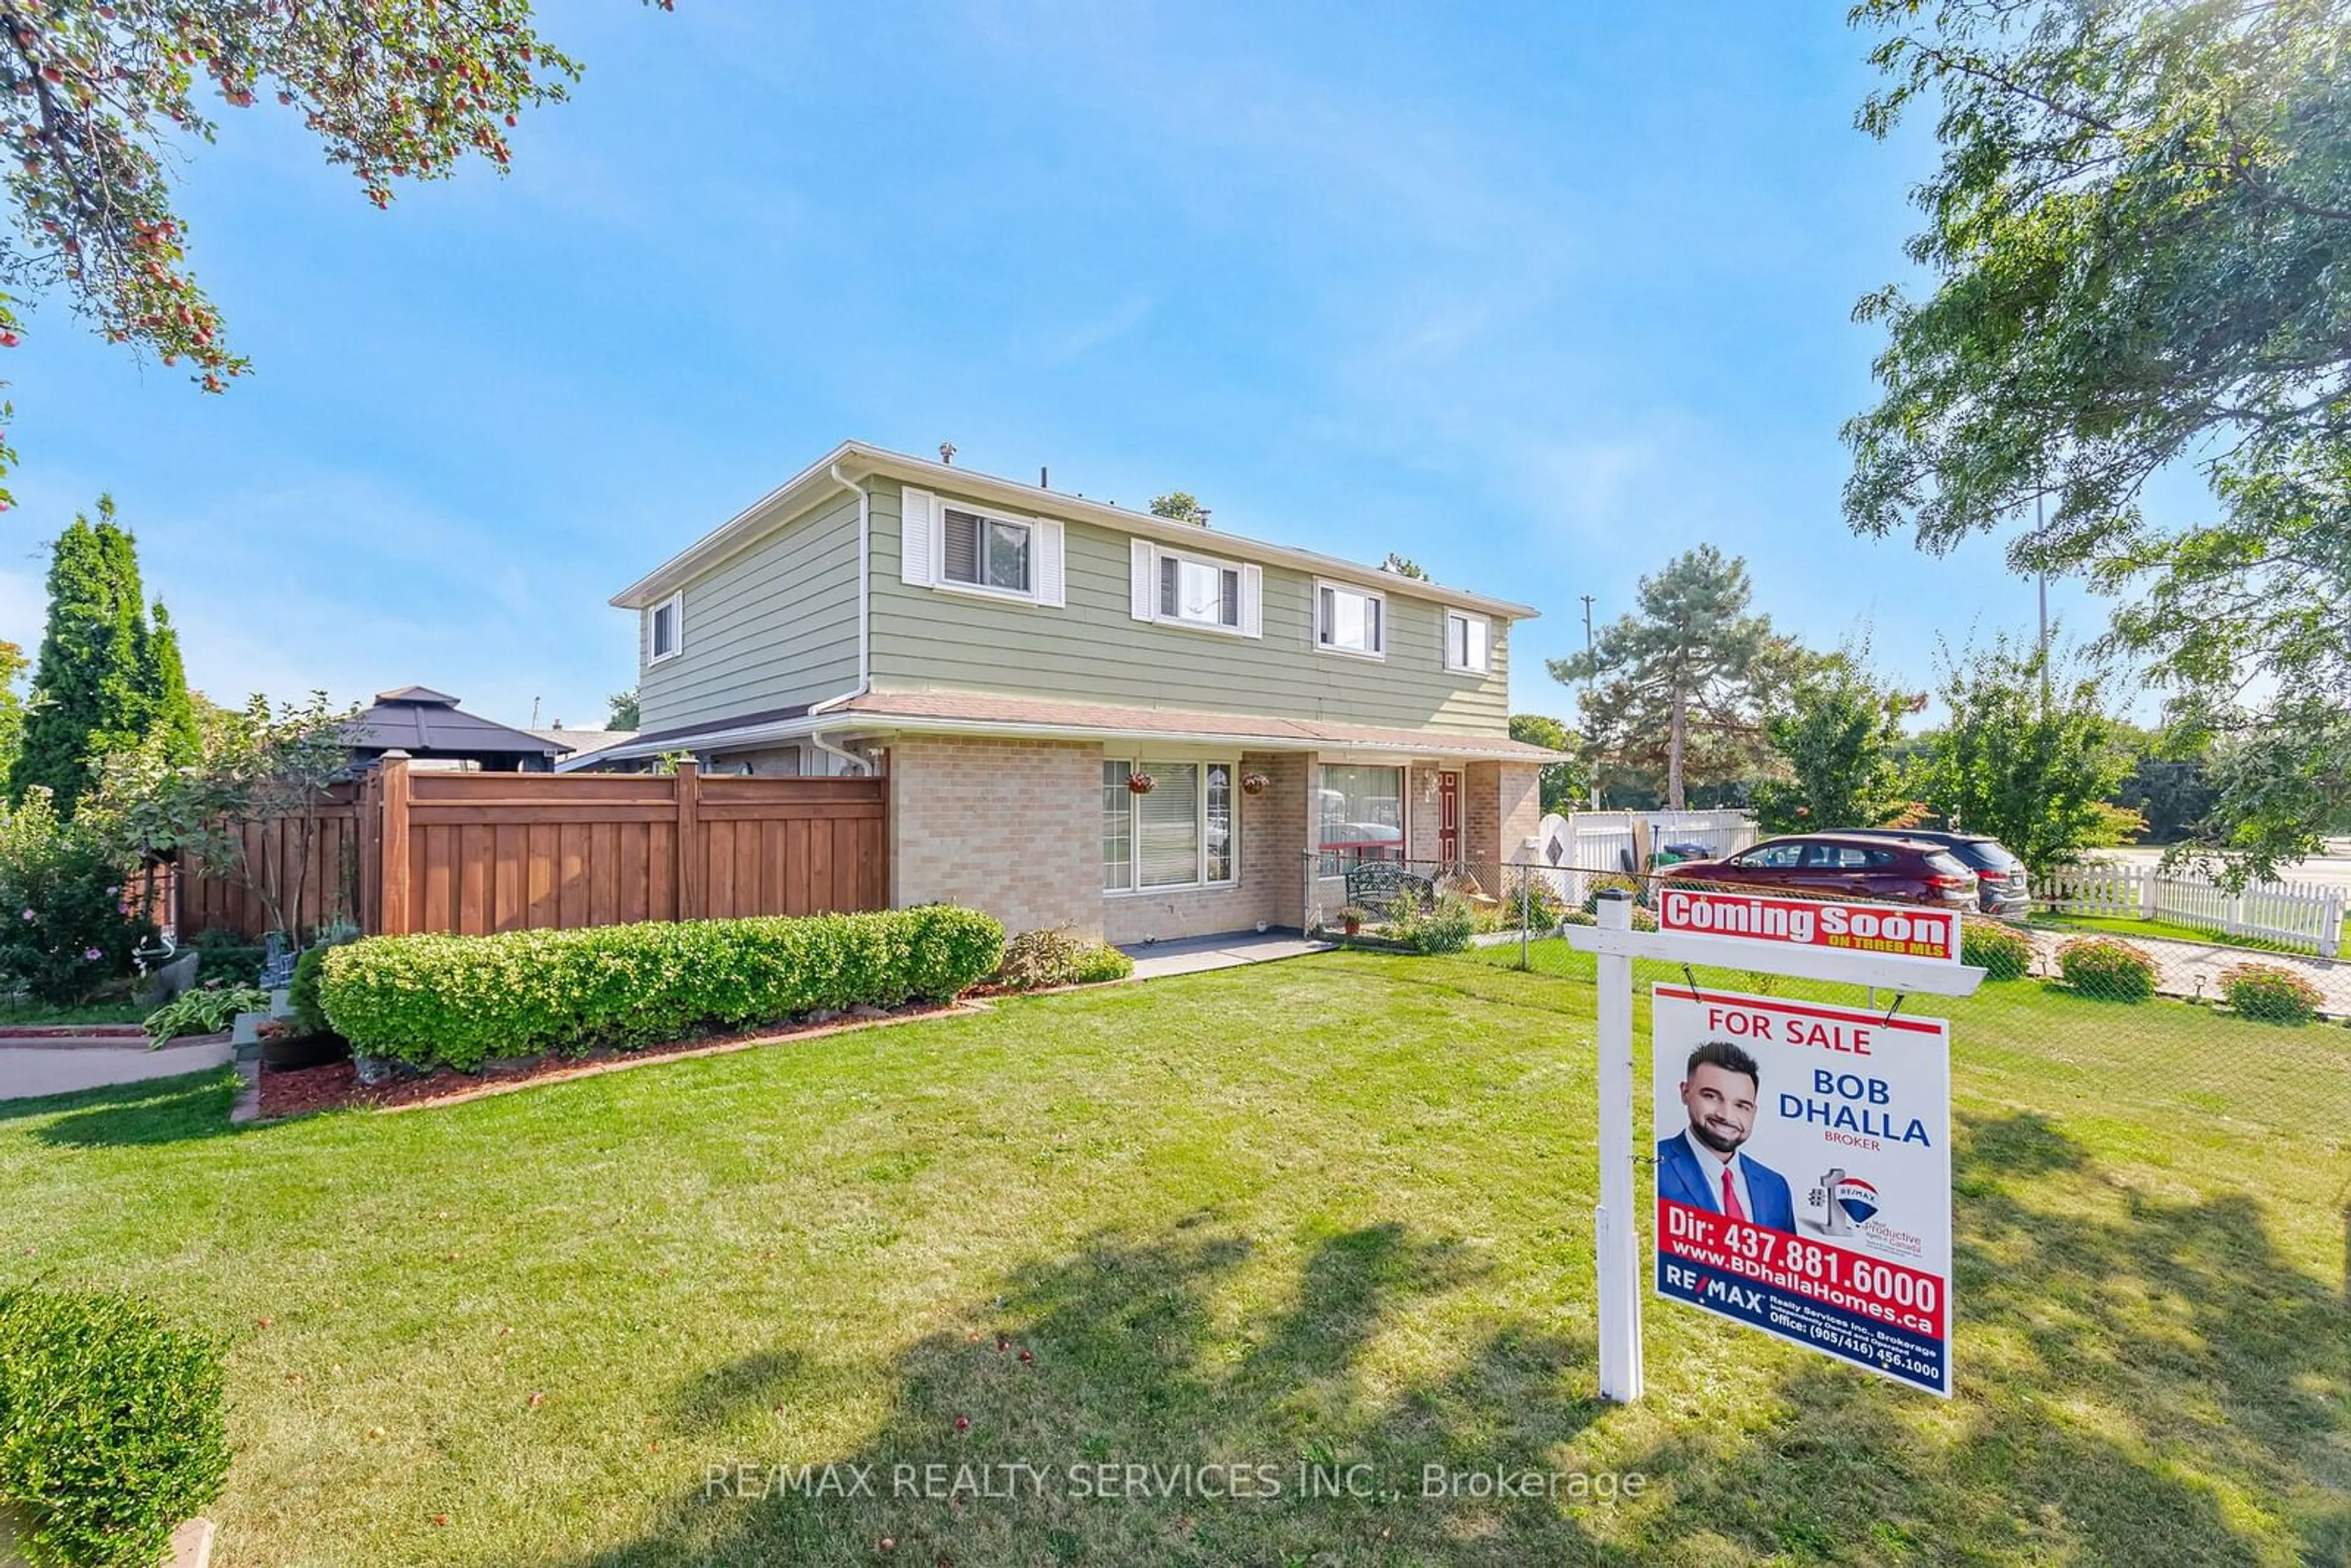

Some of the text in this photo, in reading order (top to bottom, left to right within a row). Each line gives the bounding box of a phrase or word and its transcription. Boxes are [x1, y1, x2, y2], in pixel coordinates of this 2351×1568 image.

[1667, 894, 1815, 943] Coming
[1820, 907, 1944, 943] Soon
[1828, 935, 1850, 948] ON
[1910, 942, 1944, 957] MLS
[1708, 1008, 1872, 1056] FOR SALE
[1814, 1069, 1889, 1105] BOB
[1780, 1093, 1930, 1148] DHALLA
[1824, 1130, 1881, 1152] BROKER
[1668, 1206, 1935, 1314] Dir: 437.881.6000
[1666, 1264, 1763, 1315] RE/MAX
[1672, 1240, 1933, 1335] www.BDhallaHomes.ca
[1769, 1295, 1802, 1312] Realty
[1804, 1305, 1848, 1328] Services
[1877, 1332, 1937, 1358] Brokerage
[1769, 1304, 1910, 1356] Independently Owned and Operated
[1769, 1311, 1940, 1379] Office: (905/416) 456.1000
